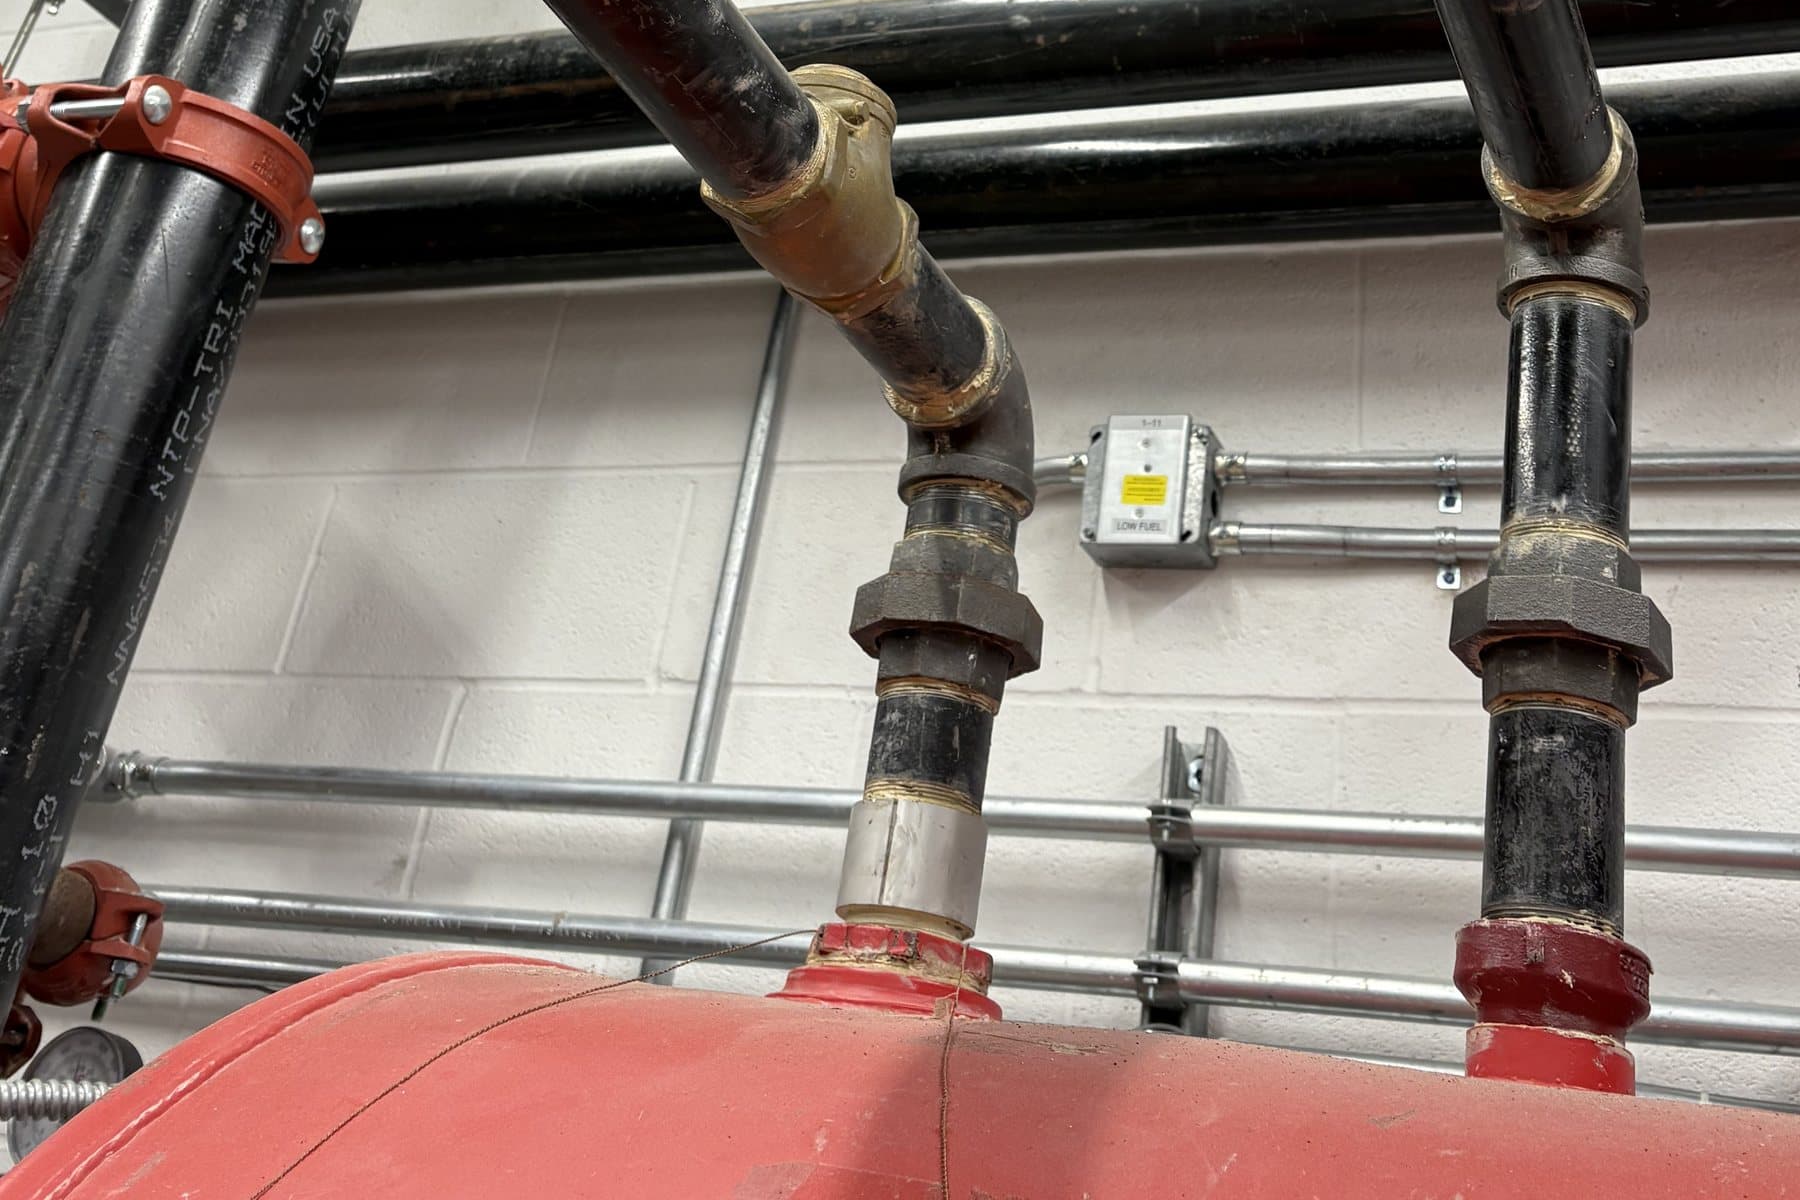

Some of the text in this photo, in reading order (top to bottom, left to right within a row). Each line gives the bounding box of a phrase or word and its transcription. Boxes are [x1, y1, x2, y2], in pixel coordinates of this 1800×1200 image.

[150, 300, 233, 501] NTP-TRI
[304, 8, 340, 78] USA
[1116, 521, 1162, 532] LOW FUEL
